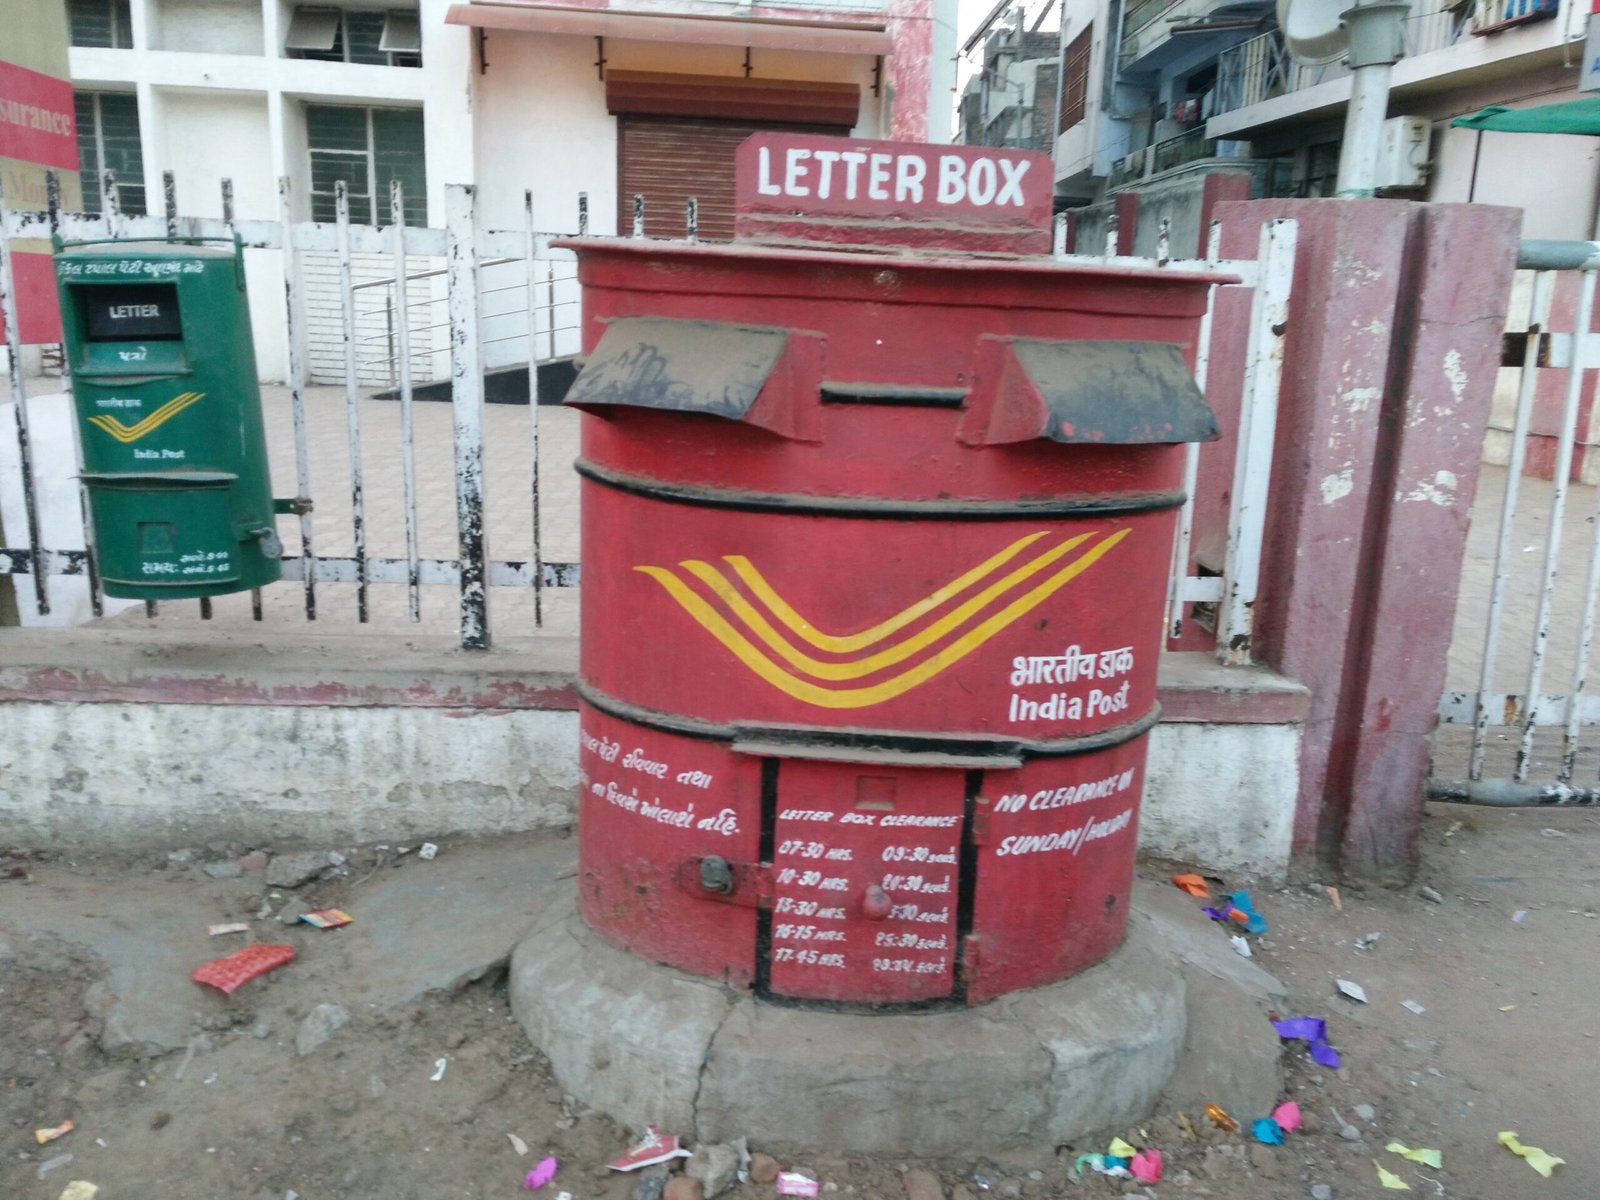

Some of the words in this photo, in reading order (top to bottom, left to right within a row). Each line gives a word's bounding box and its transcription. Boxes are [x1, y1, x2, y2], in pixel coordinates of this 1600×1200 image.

[757, 146, 926, 203] LETTER
[936, 155, 1031, 207] BOX
[109, 304, 159, 319] LETTER
[134, 449, 160, 459] India
[161, 449, 185, 459] Post
[1010, 644, 1098, 687] भारतीय
[1097, 646, 1134, 680] डाक
[1009, 692, 1083, 722] India
[1086, 680, 1131, 718] Post
[622, 748, 669, 779] રવિવાર
[676, 770, 713, 789] તથા
[993, 794, 1026, 813] NO
[1028, 773, 1120, 811] CLEARANCE
[779, 809, 834, 822] LETTER
[839, 812, 876, 826] BOX
[879, 815, 958, 827] CLEARANCE
